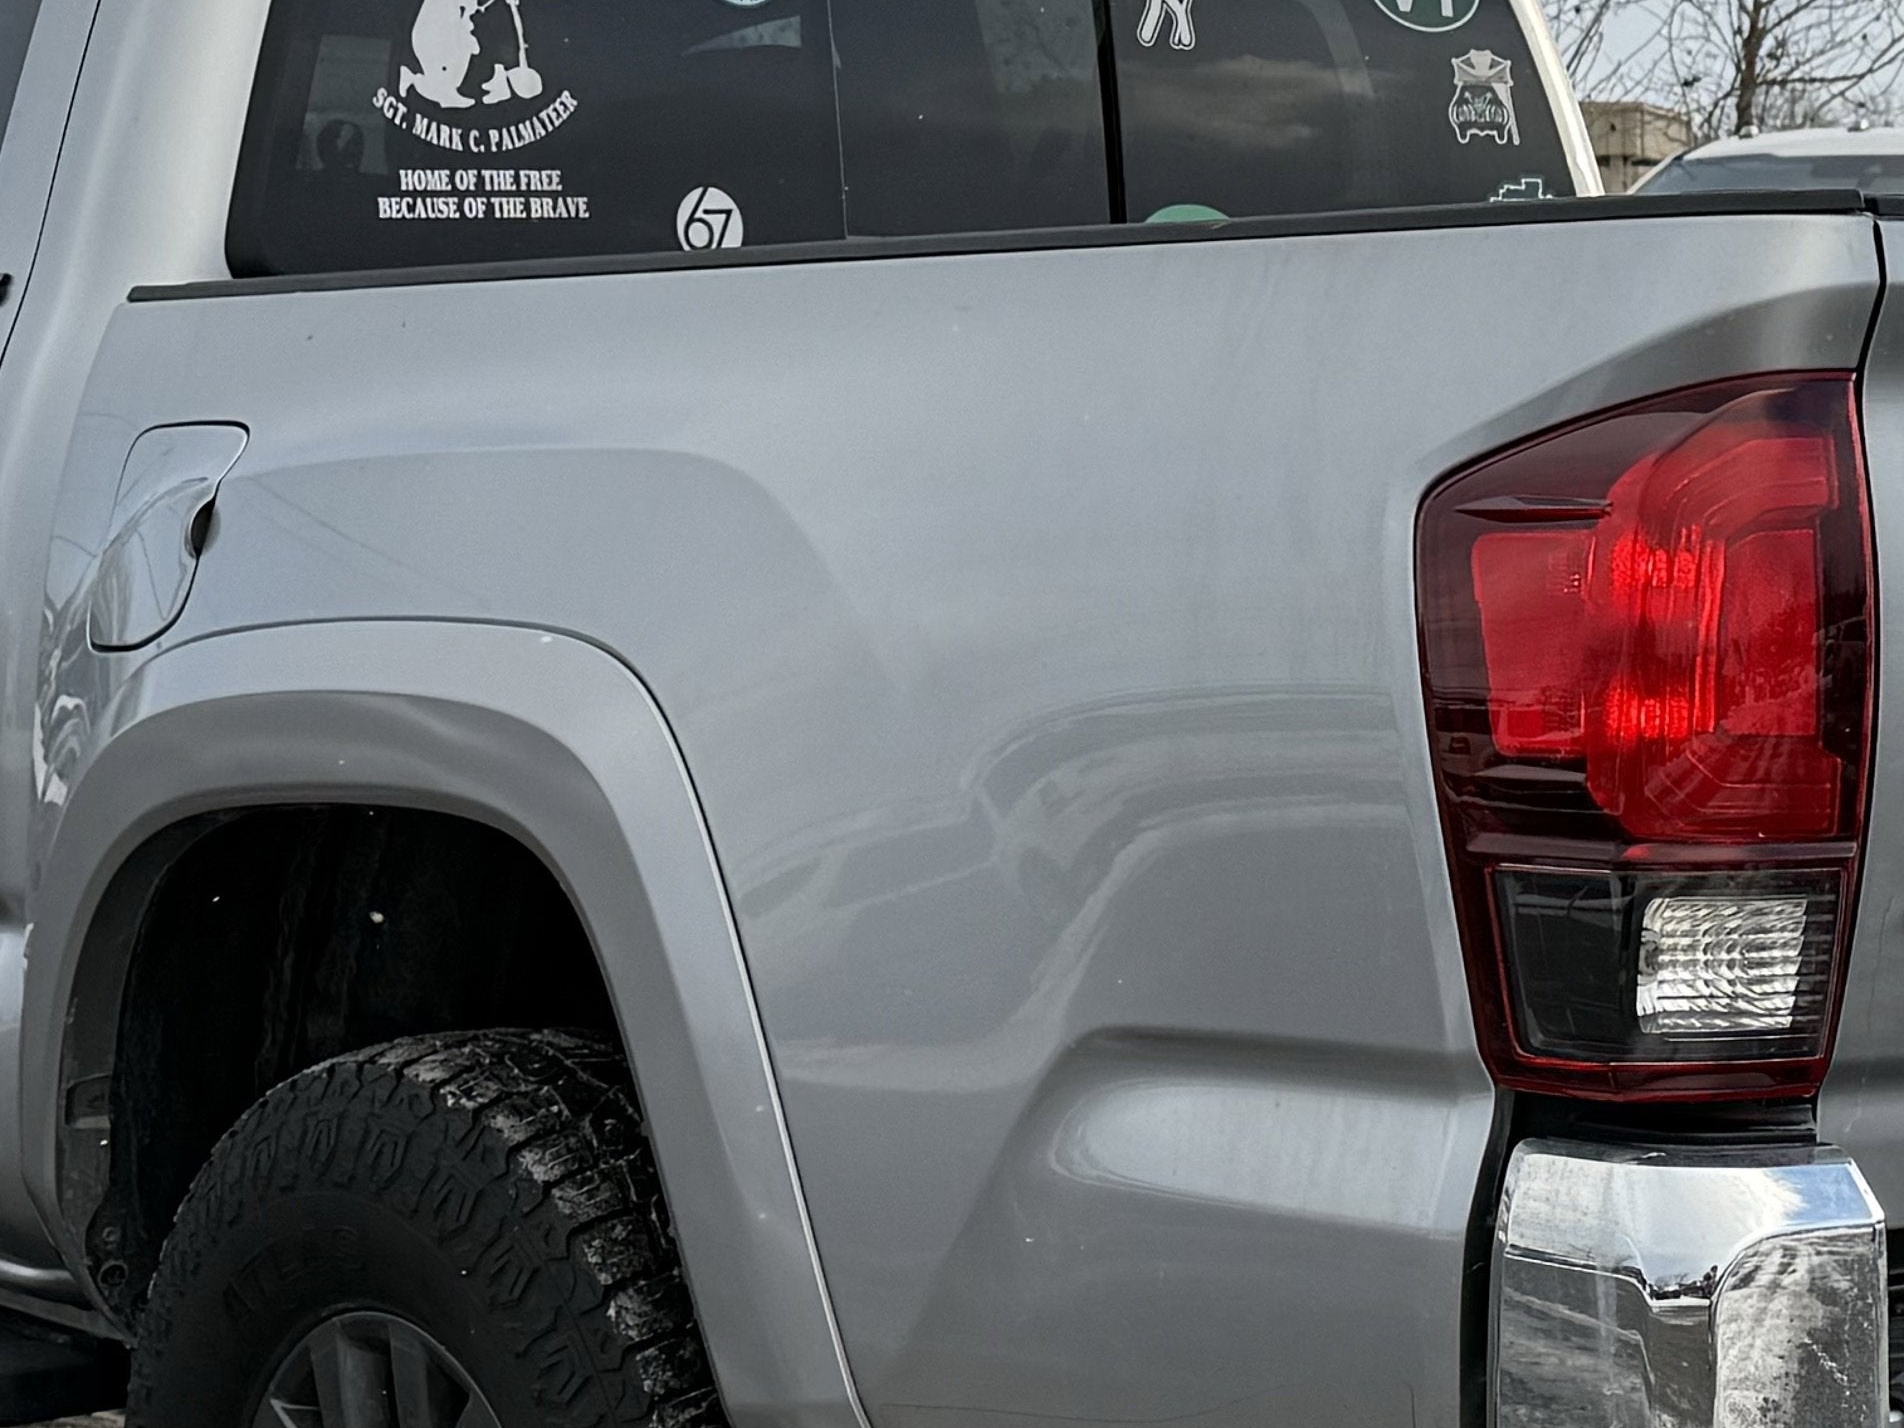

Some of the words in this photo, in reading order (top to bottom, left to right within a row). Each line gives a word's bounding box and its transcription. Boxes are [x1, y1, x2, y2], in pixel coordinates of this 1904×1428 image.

[372, 87, 408, 129] SGT.
[412, 113, 464, 151] MARK
[469, 129, 485, 152] C.
[489, 90, 578, 152] PALMATEER
[399, 169, 451, 191] HOME
[455, 169, 478, 191] OF
[481, 169, 516, 191] THE
[519, 169, 563, 192] FREE
[377, 196, 460, 218] BECAUSE
[463, 196, 487, 218] OF
[491, 196, 527, 218] THE
[530, 196, 590, 218] BRAVE
[684, 186, 733, 250] 67
